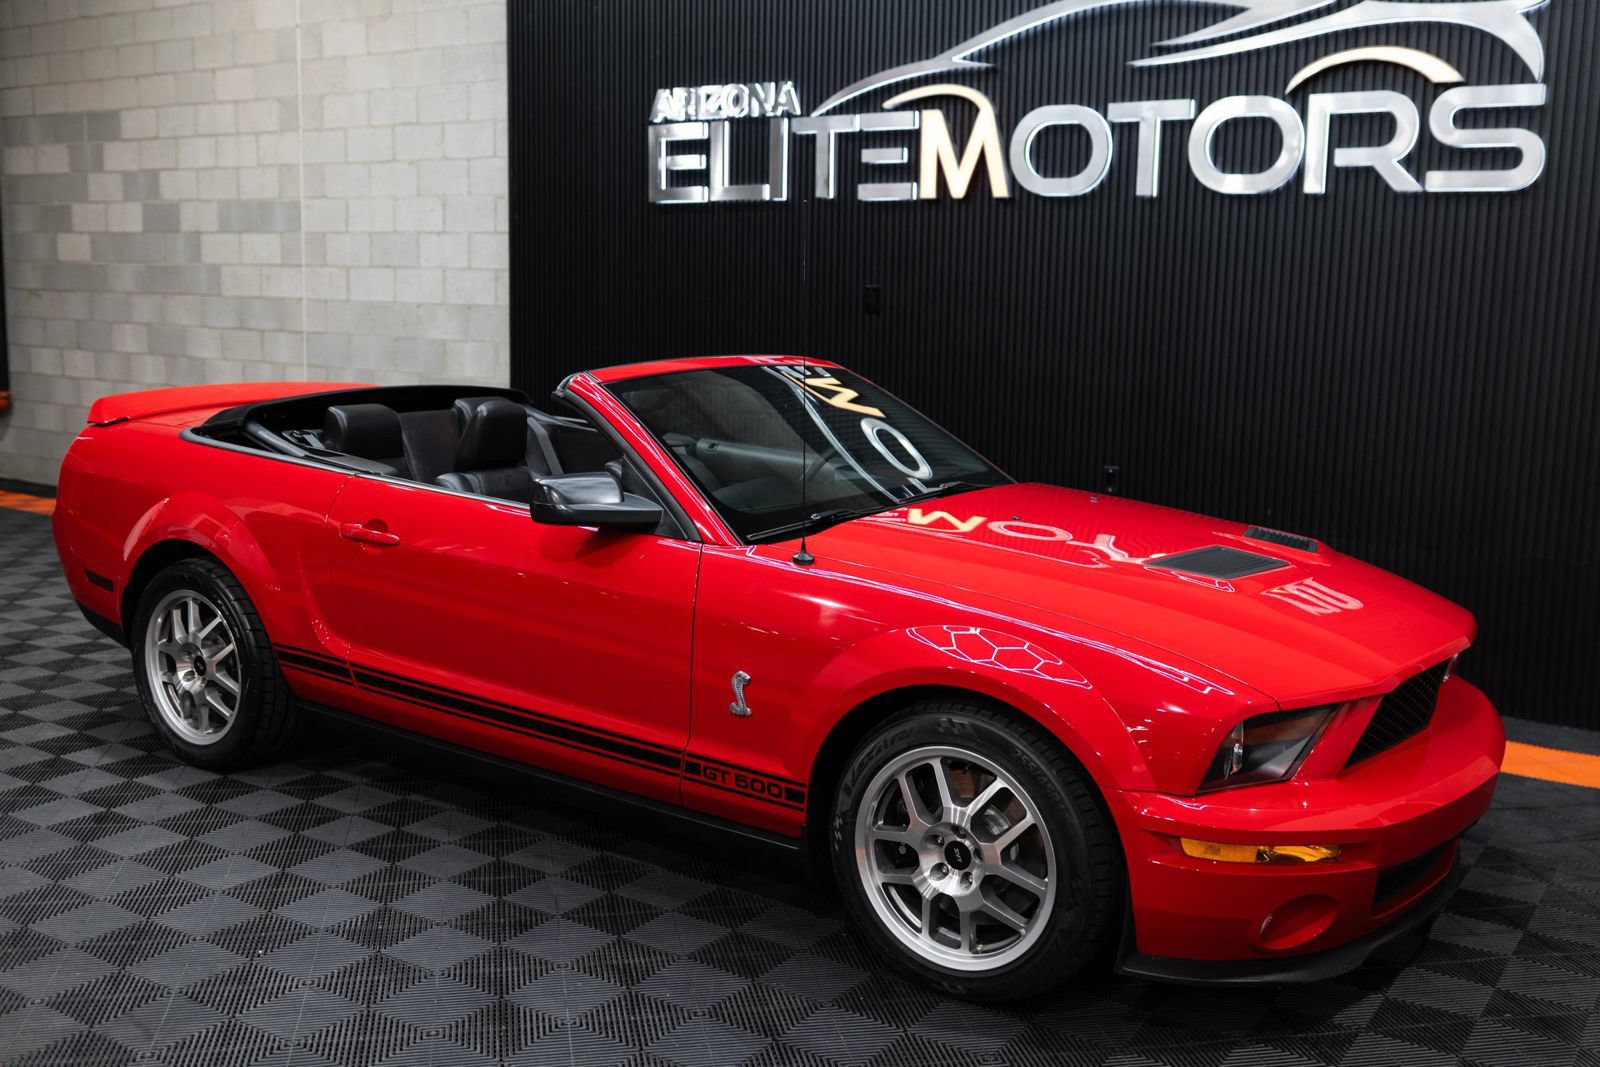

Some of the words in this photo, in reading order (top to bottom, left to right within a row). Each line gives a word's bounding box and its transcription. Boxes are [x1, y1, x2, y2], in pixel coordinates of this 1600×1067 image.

[648, 81, 802, 123] ARIZONA
[703, 766, 730, 784] GT
[735, 774, 783, 798] 500
